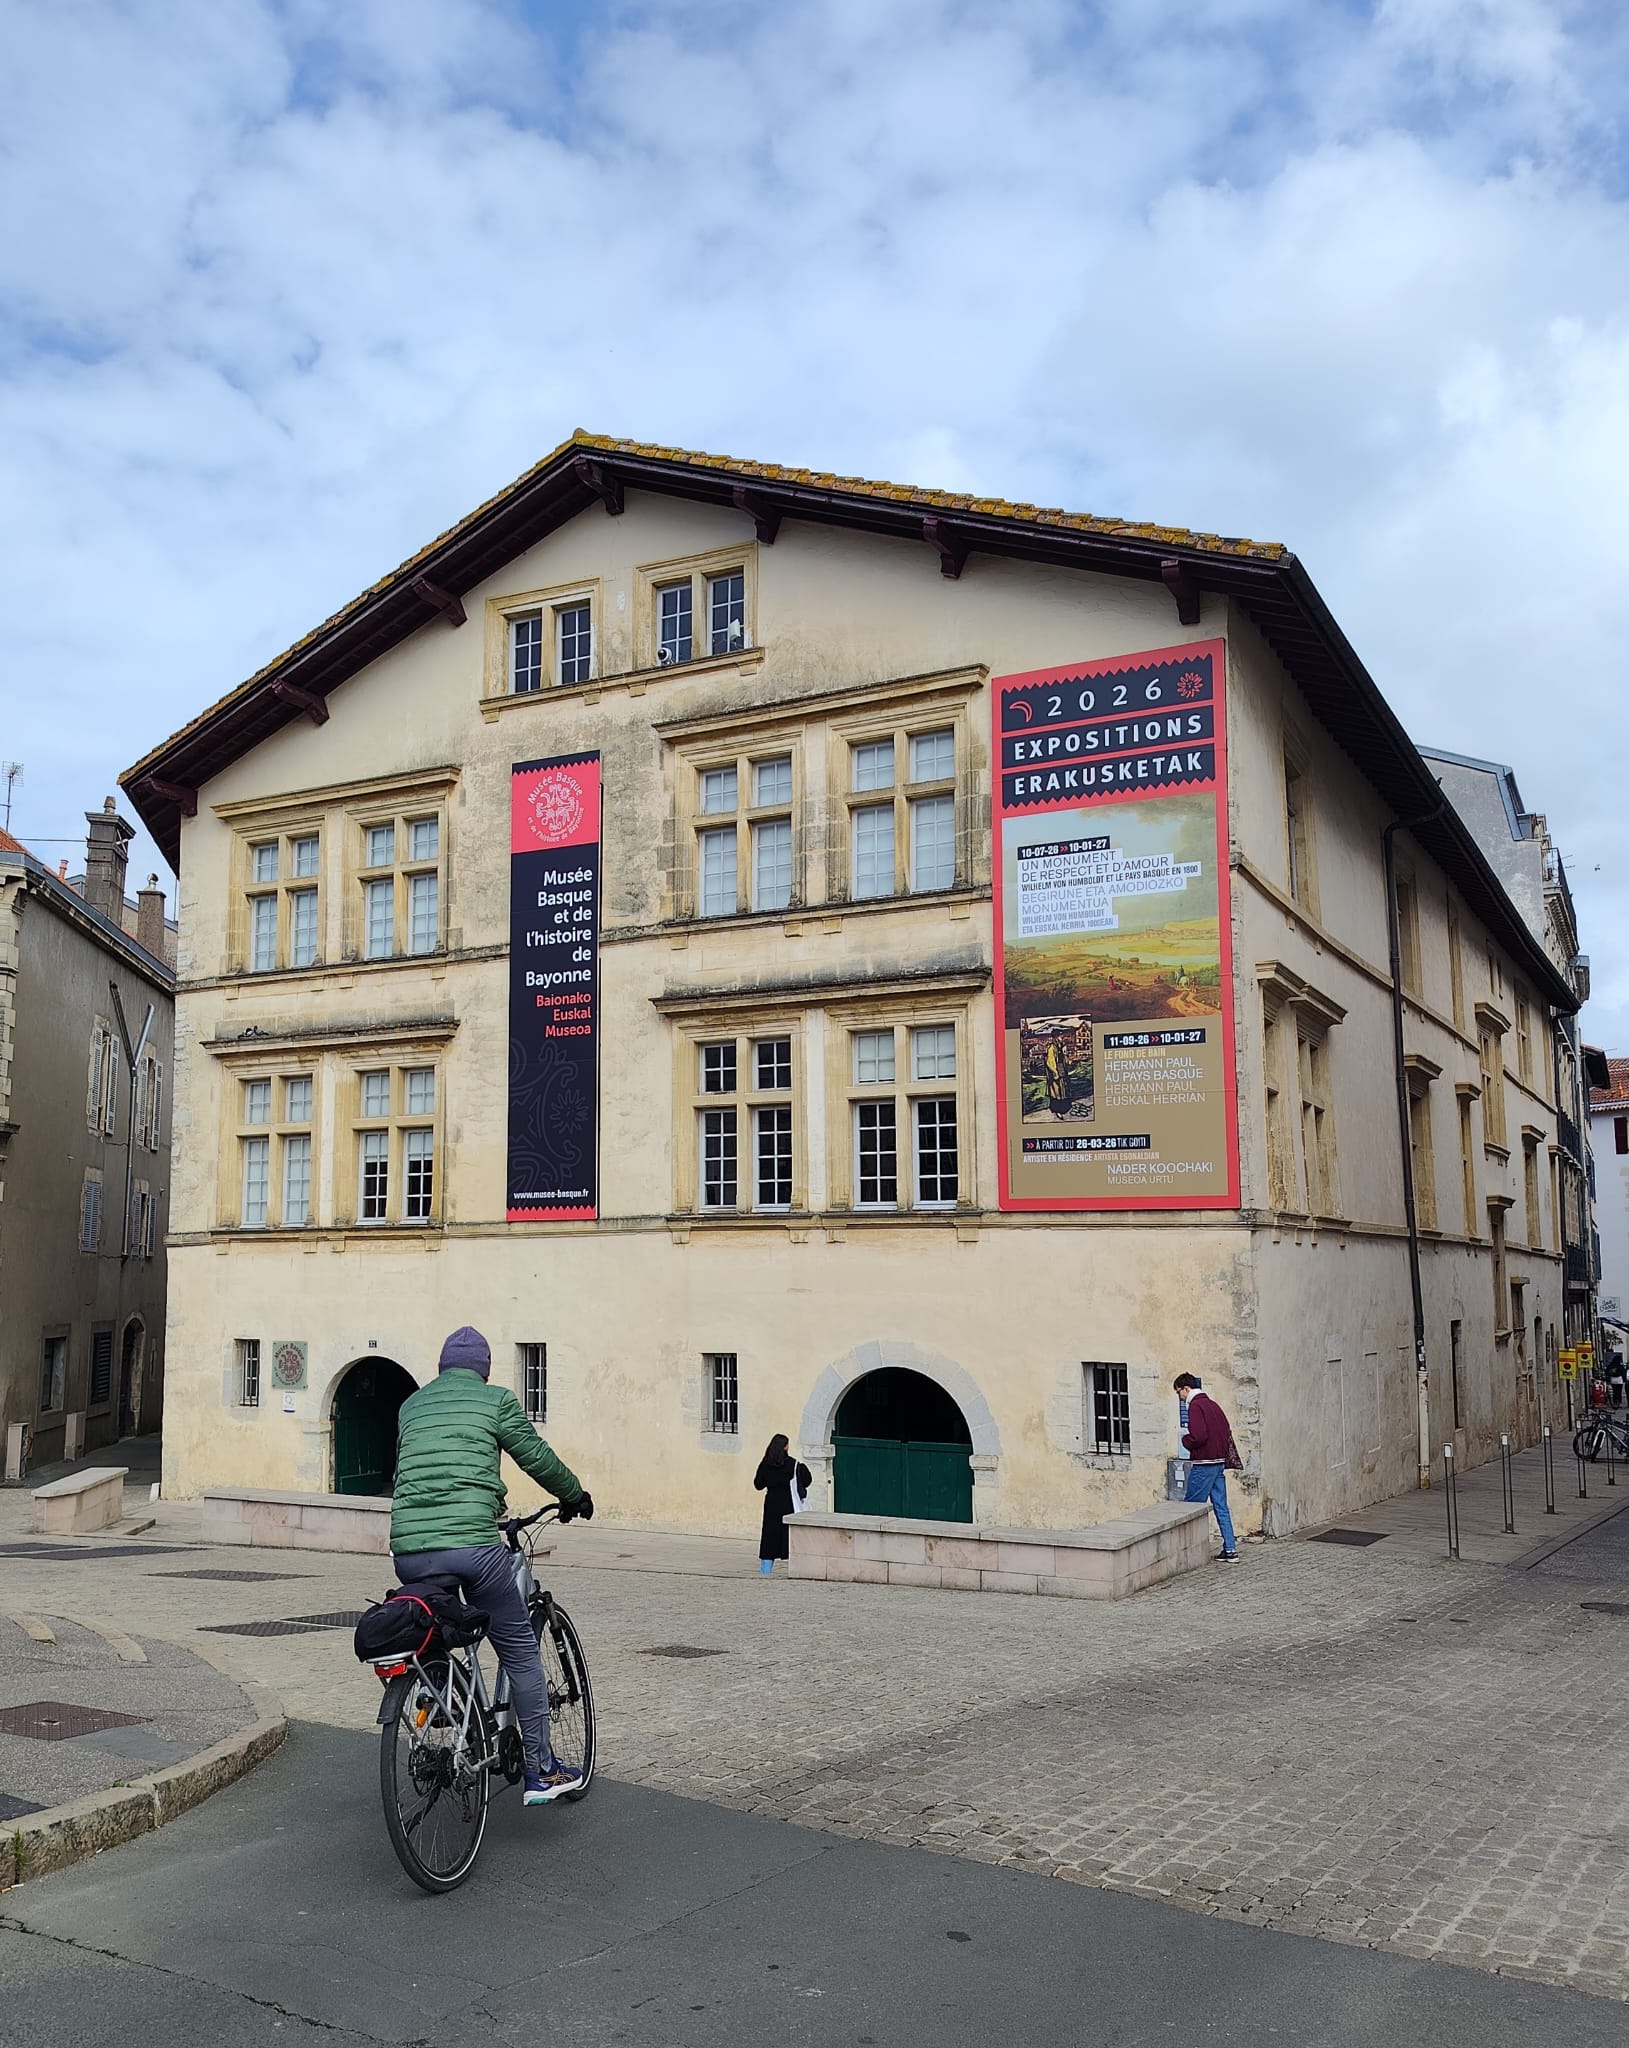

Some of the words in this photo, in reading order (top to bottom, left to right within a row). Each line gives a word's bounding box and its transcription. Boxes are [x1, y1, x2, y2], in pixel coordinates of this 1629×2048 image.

[1047, 679, 1162, 717] 2026
[1014, 714, 1201, 760] EXPOSITIONS
[1014, 752, 1202, 795] ERAKUSKETAK
[528, 776, 552, 804] Musée
[556, 772, 582, 796] Basque
[1022, 845, 1058, 858] 10-07-26
[1069, 839, 1107, 852] 10-01-27
[1022, 861, 1038, 871] UN
[1043, 851, 1116, 869] MONUMENT
[543, 867, 592, 886] Musée
[1022, 872, 1037, 882] DE
[1040, 865, 1092, 880] RESPECT
[1096, 863, 1109, 874] ET
[1113, 857, 1168, 872] D'AMOUR
[1022, 882, 1051, 892] WILHELM
[1054, 880, 1066, 888] VON
[1068, 876, 1104, 886] HUMBOLDT
[1106, 874, 1114, 882] ET
[1116, 873, 1123, 881] LE
[1125, 872, 1140, 880] PAYS
[1143, 868, 1170, 878] BASQUE
[1172, 866, 1181, 875] EN
[1184, 865, 1198, 874] 1800
[1022, 888, 1082, 904] BEGIRUNE
[1086, 886, 1106, 897] ETA
[1108, 877, 1183, 894] AMODIOZKO
[538, 890, 592, 907] Basque
[1022, 897, 1109, 915] MONUMENTUA
[554, 910, 568, 923] et
[573, 906, 592, 921] de
[1022, 914, 1051, 924] WILHELM
[1054, 913, 1066, 921] VON
[1069, 909, 1104, 920] HUMBOLDT
[1022, 926, 1033, 934] ETA
[1035, 923, 1059, 933] EUSKAL
[1061, 921, 1085, 930] HERRIA
[526, 927, 592, 947] l'histoire
[573, 948, 591, 961] de
[526, 969, 591, 988] Bayonne
[536, 992, 591, 1007] Baionako
[553, 1007, 591, 1021] Euskal
[545, 1024, 591, 1038] Museoa
[1110, 1035, 1149, 1046] 11-09-26
[1160, 1031, 1201, 1043] 10-01-27
[1104, 1050, 1113, 1060] LE
[1114, 1050, 1134, 1059] FOND
[1136, 1049, 1146, 1058] DE
[1104, 1059, 1162, 1071] HERMANN
[1166, 1057, 1195, 1067] PAUL
[1104, 1072, 1119, 1083] AU
[1123, 1070, 1150, 1082] PAYS
[1154, 1068, 1205, 1080] BASQUE
[1106, 1082, 1163, 1095] HERMANN
[1167, 1081, 1196, 1091] PAUL
[1106, 1095, 1150, 1106] EUSKAL
[1153, 1092, 1206, 1104] HERRIAN
[1042, 1140, 1064, 1150] PARTIR
[1065, 1139, 1074, 1149] DU
[1076, 1139, 1116, 1149] 26-03-26
[1058, 1153, 1092, 1162] RÉSIDENCE
[1093, 1152, 1118, 1160] ARTISTA
[1108, 1164, 1146, 1174] NADER
[1149, 1162, 1212, 1174] KOOCHAKI
[1108, 1176, 1147, 1184] MUSEOA
[1149, 1175, 1174, 1184] URTU
[514, 1188, 589, 1199] www.musee-basque.fr
